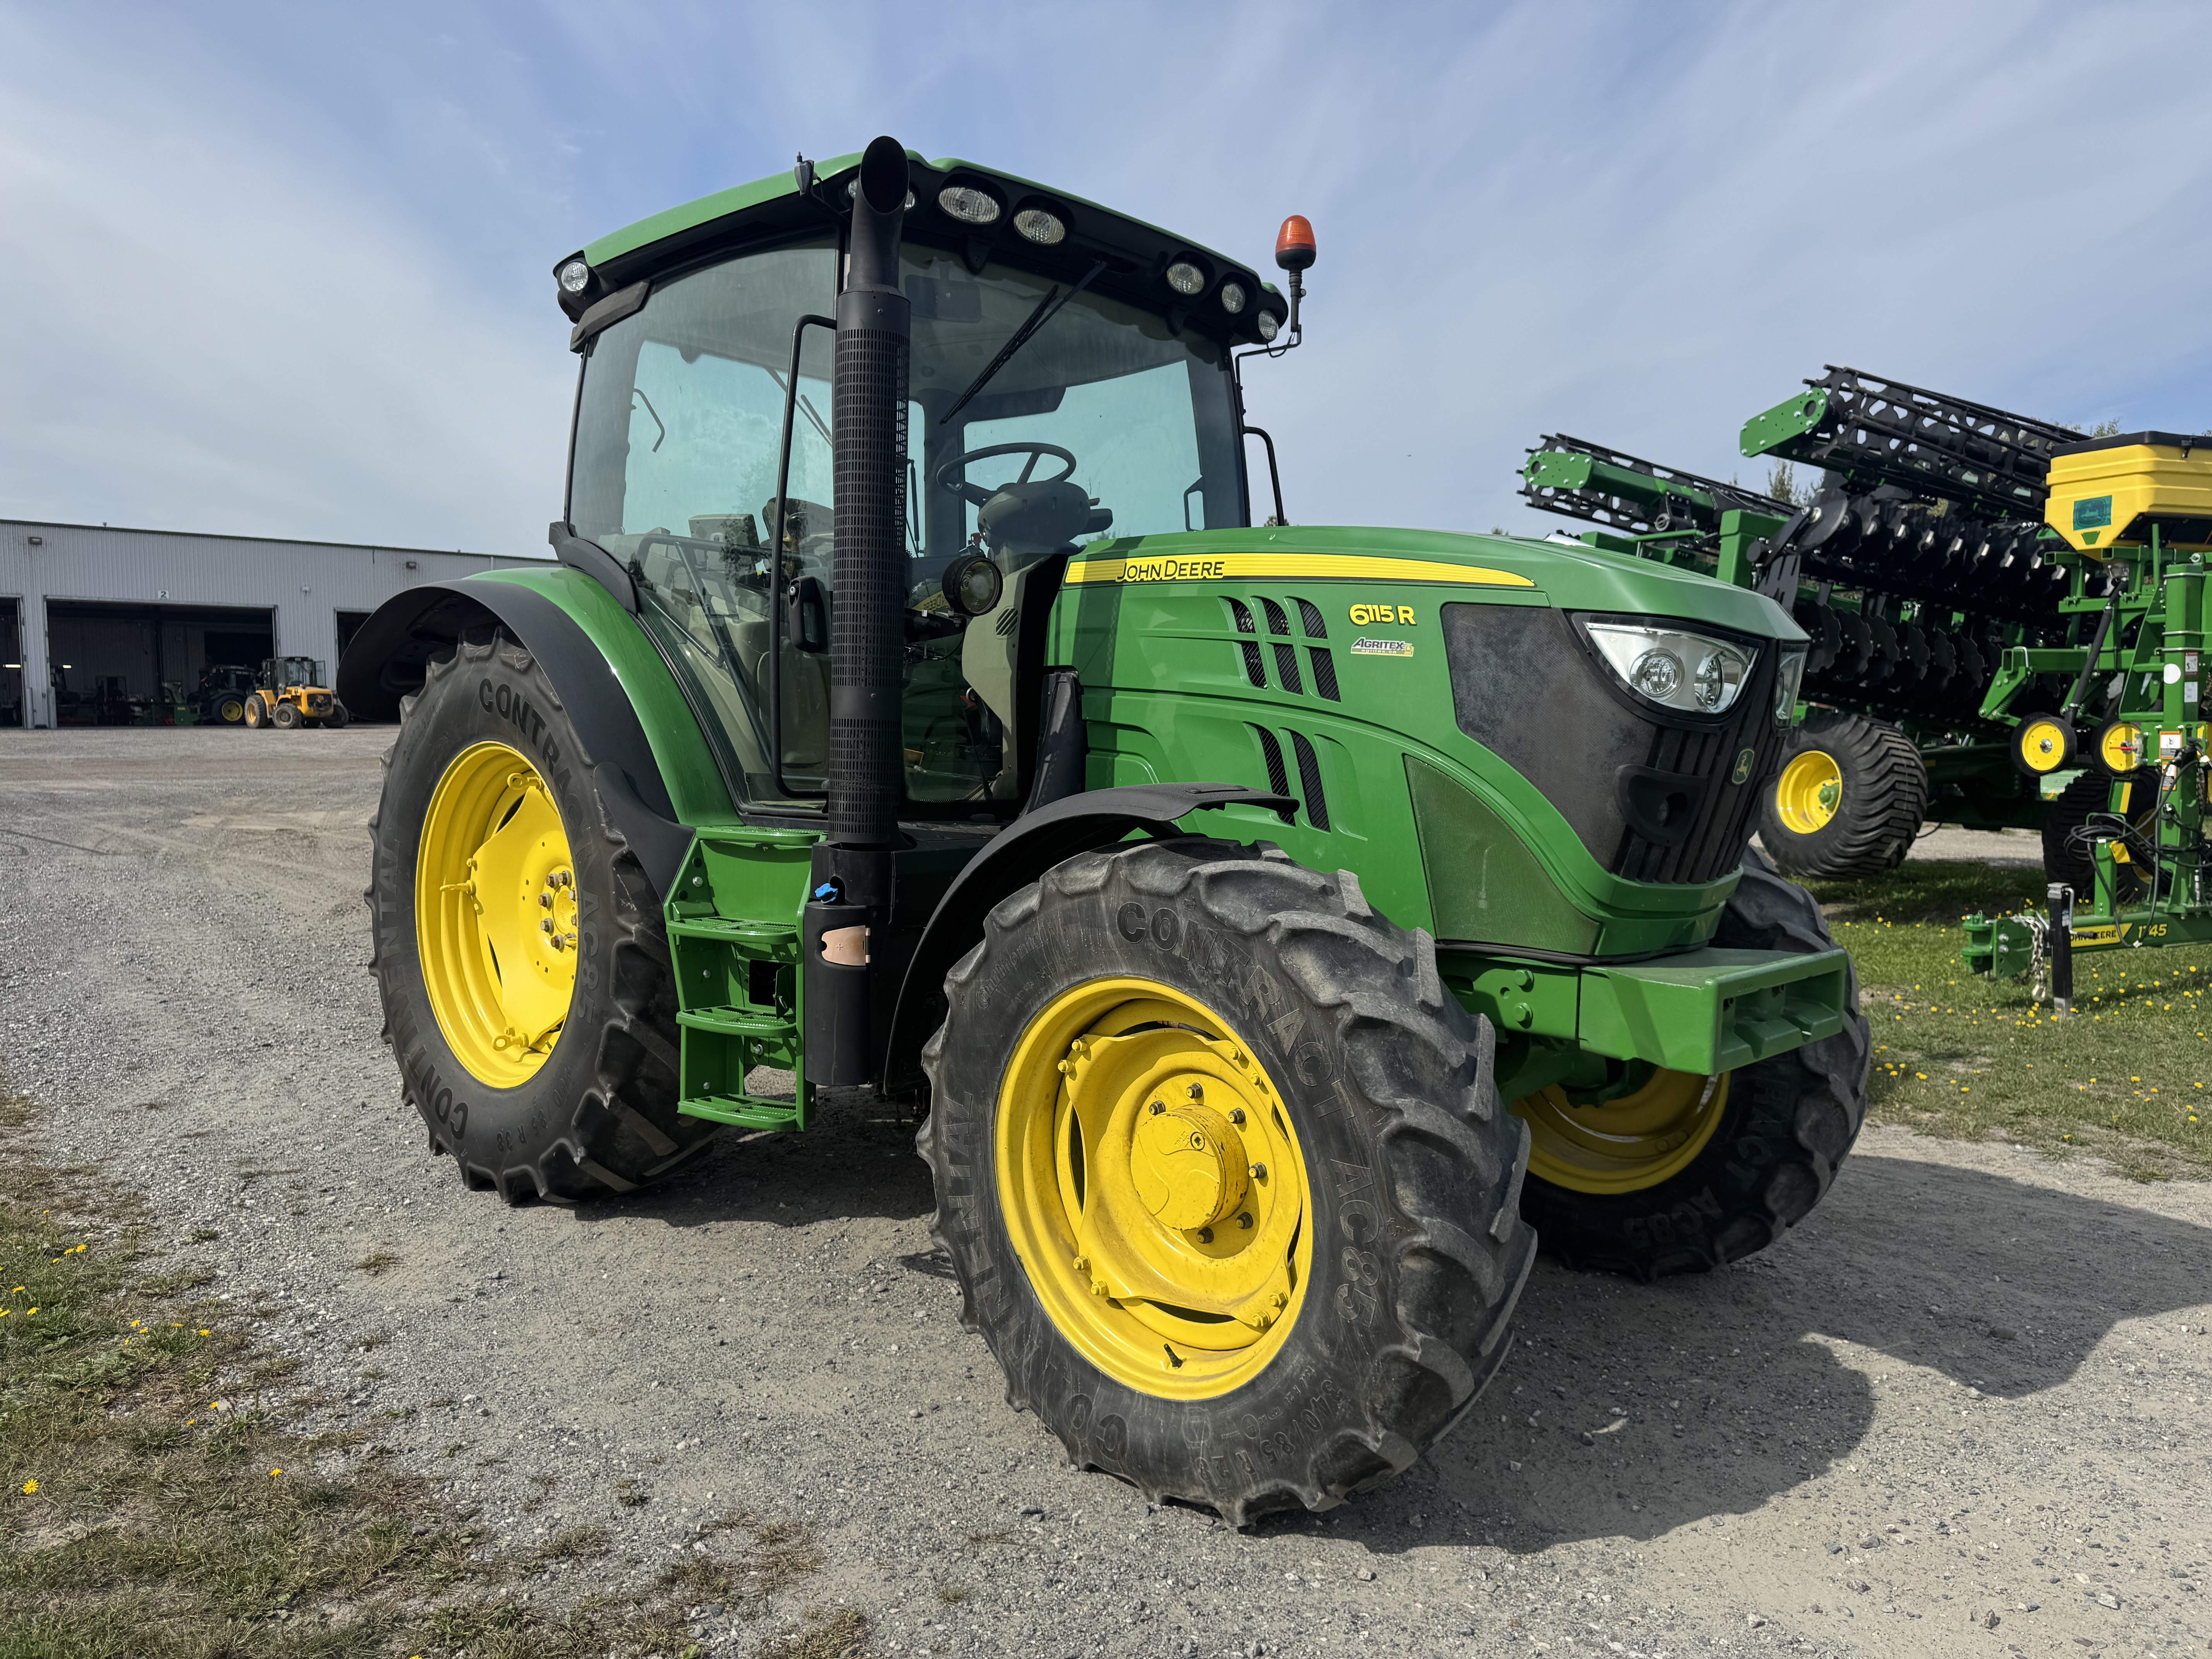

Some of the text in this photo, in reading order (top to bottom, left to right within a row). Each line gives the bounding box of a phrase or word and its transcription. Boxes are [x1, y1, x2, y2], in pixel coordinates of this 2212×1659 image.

[1117, 560, 1225, 580] JOHN DEERE
[1350, 604, 1417, 625] 6115 R
[1352, 639, 1404, 649] AGRITEX
[1116, 902, 1355, 1120] CONTRACT
